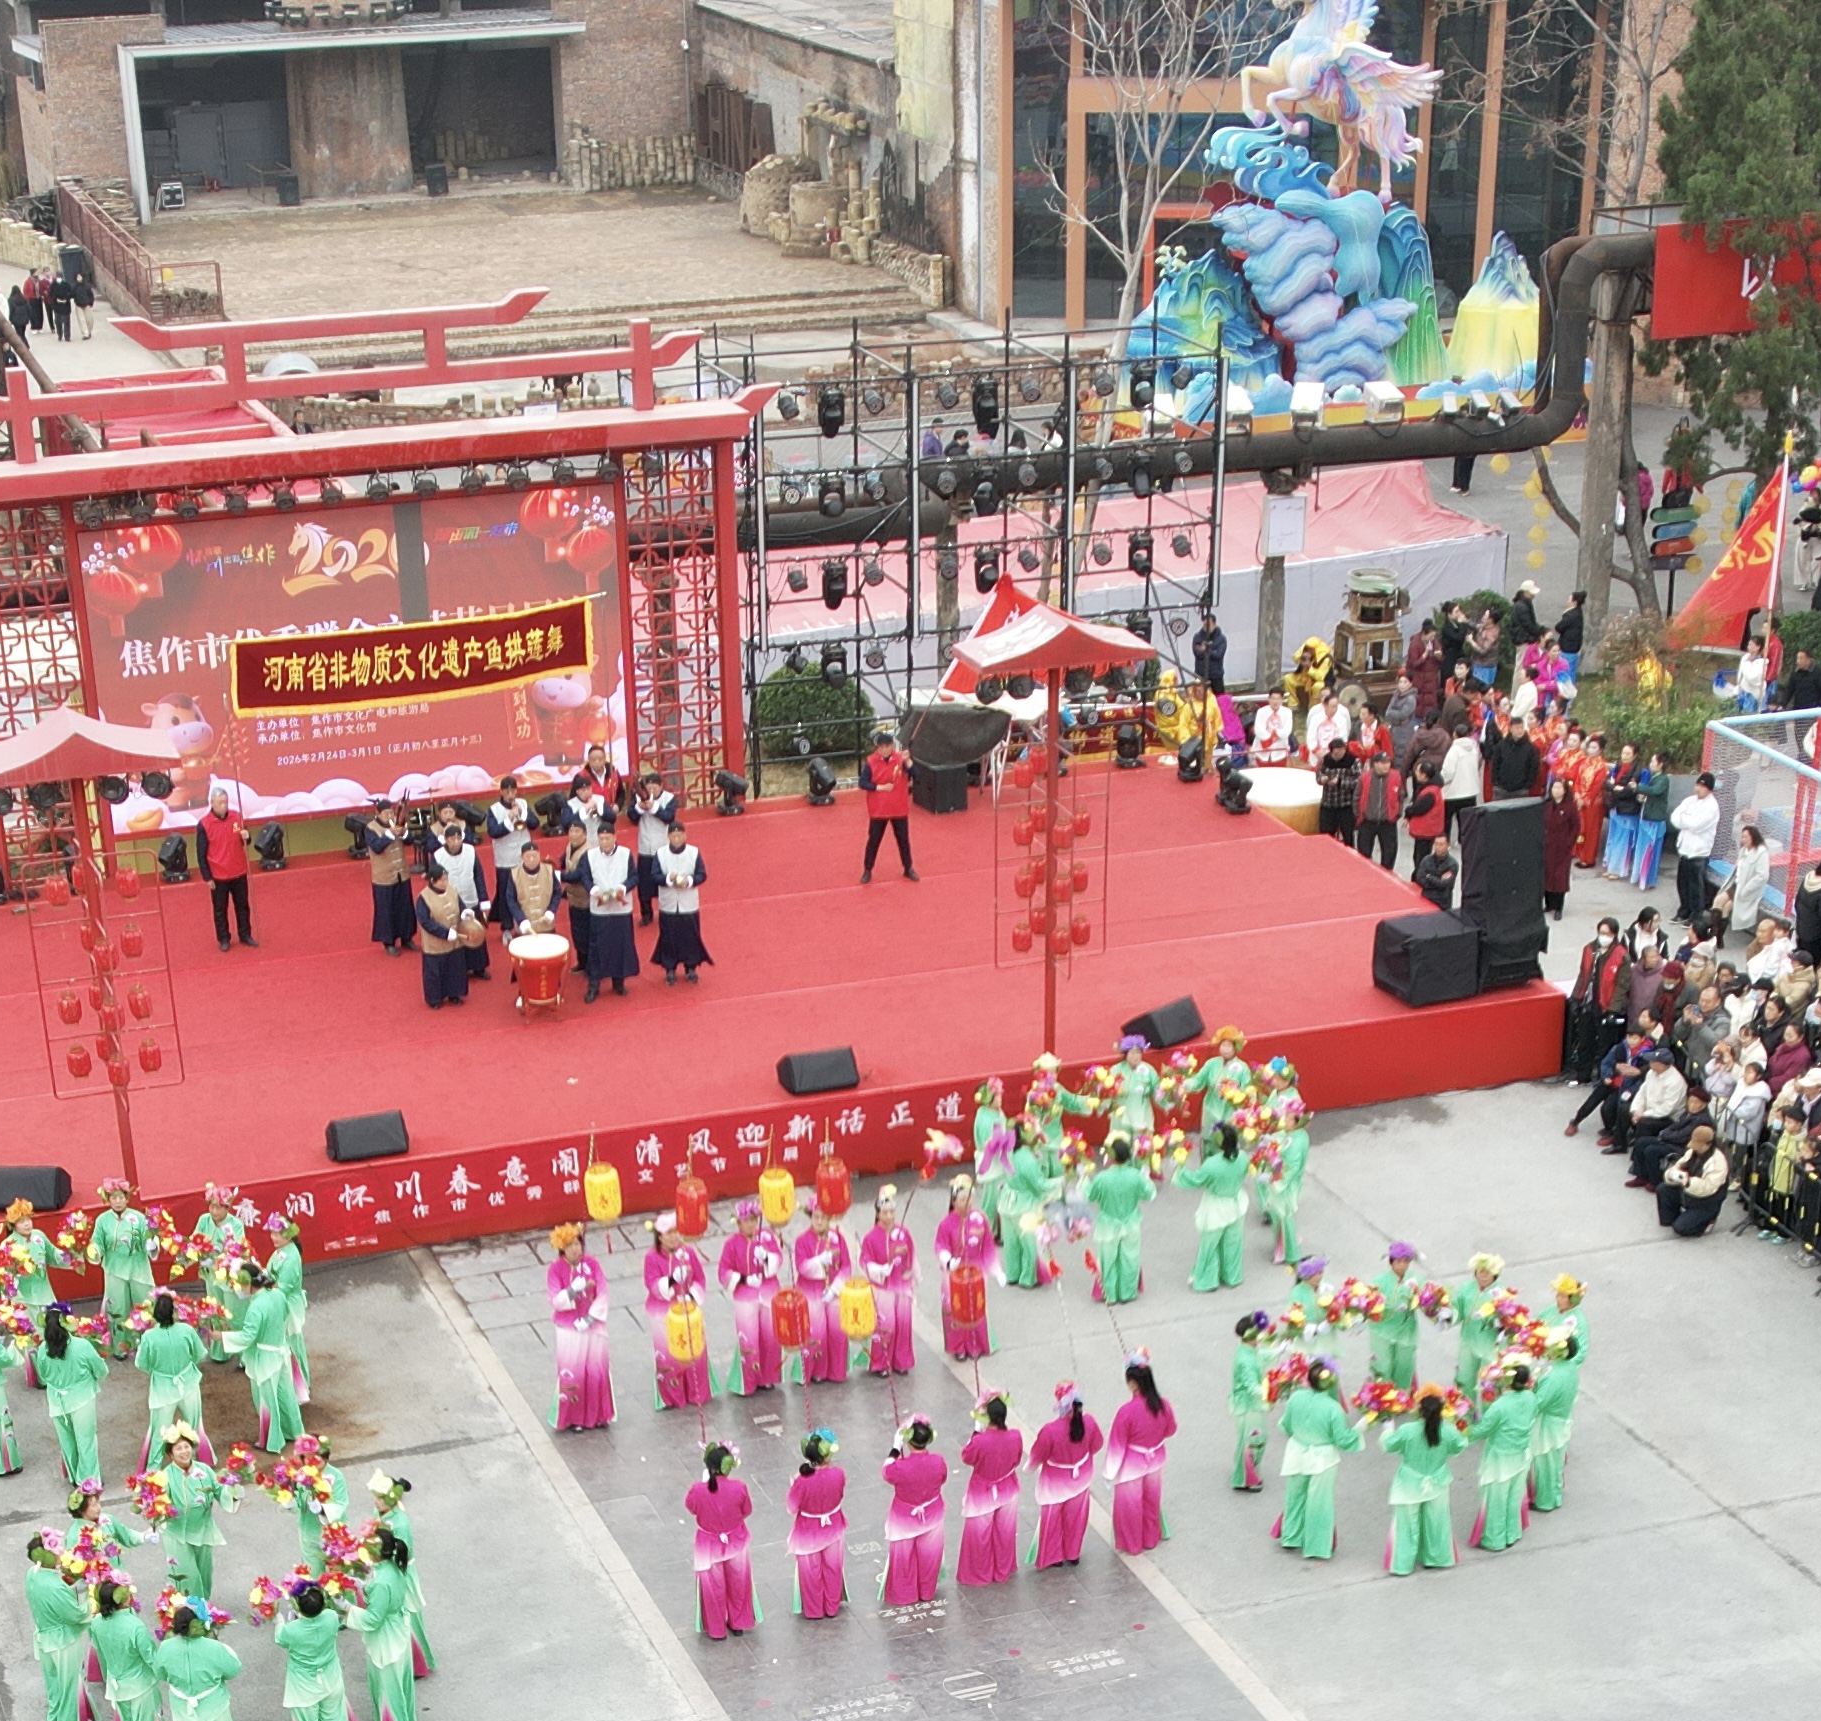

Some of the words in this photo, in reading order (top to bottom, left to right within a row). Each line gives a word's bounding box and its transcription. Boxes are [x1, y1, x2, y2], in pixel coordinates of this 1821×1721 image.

[263, 623, 564, 693] 河南省非物质文化遗产鱼拱莲舞
[513, 684, 531, 739] 到成功
[374, 1141, 834, 1224] 焦作市优秀群文艺节目展演
